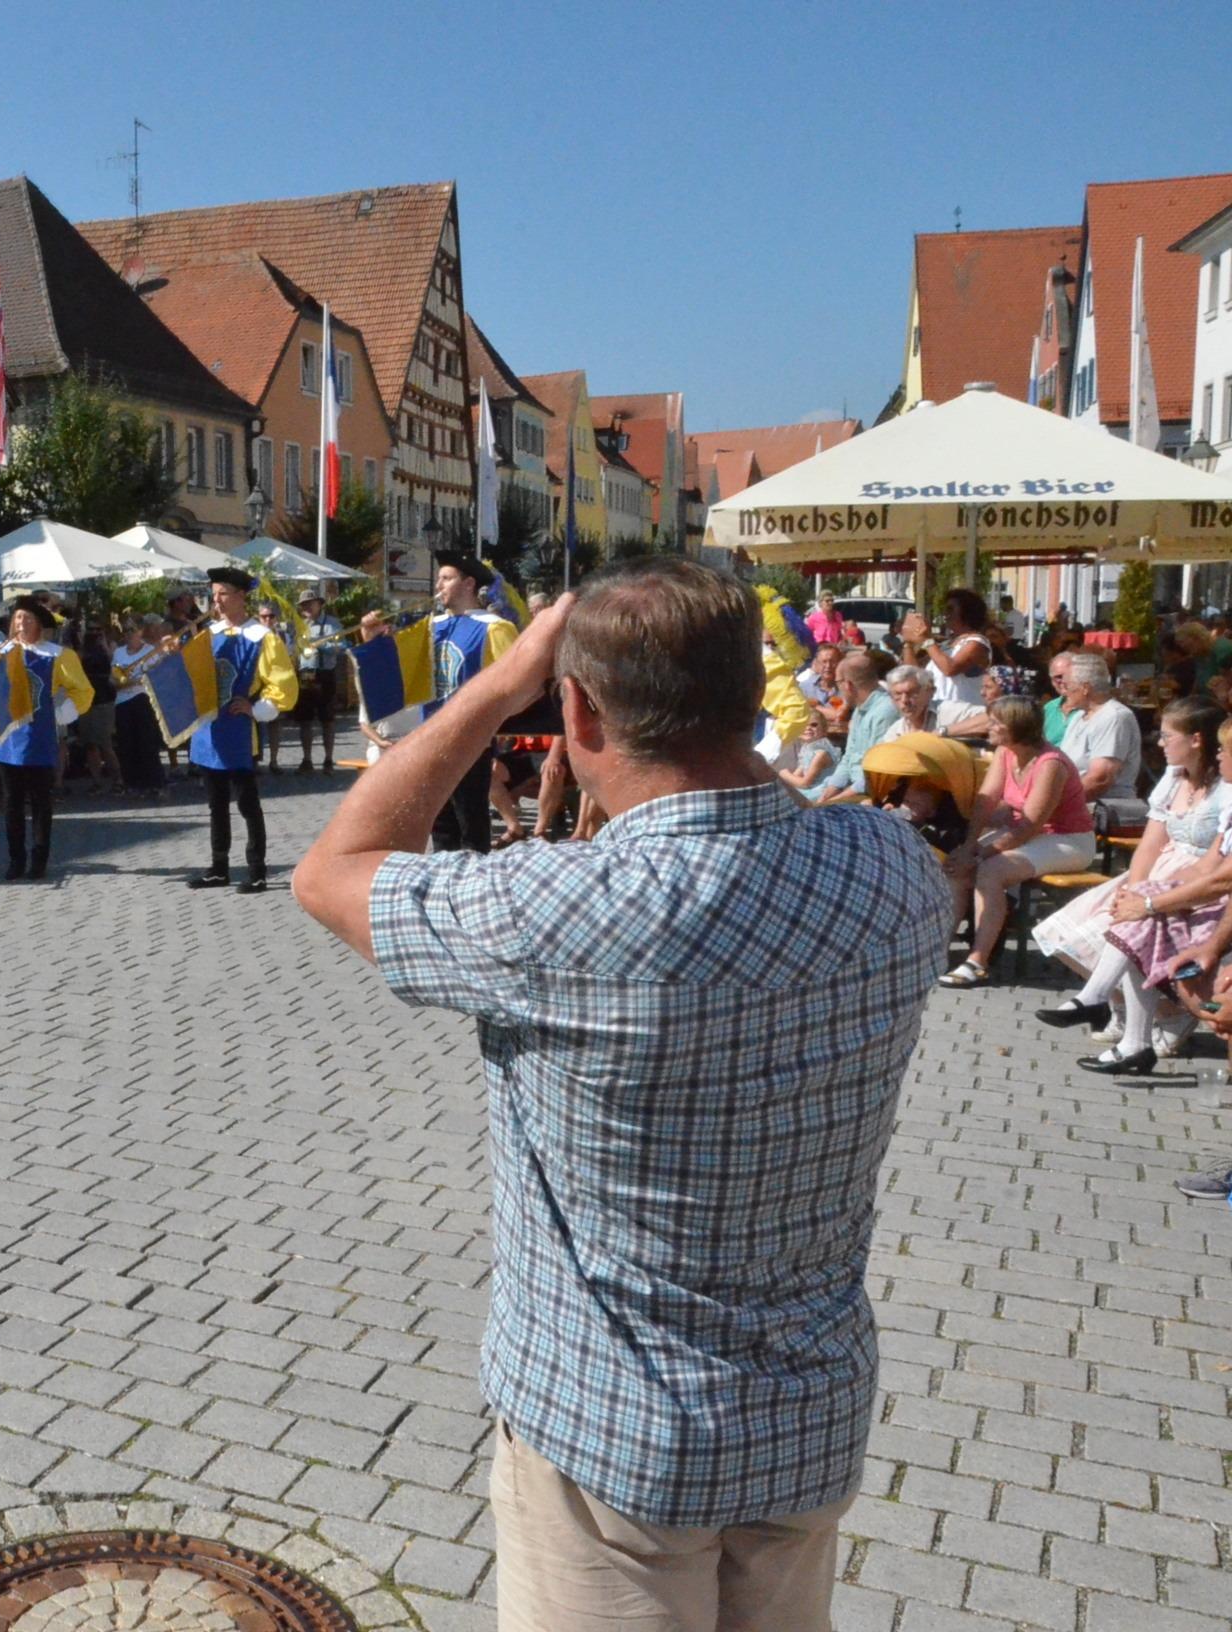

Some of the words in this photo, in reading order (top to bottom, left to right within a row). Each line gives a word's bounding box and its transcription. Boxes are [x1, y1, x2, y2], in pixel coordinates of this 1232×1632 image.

[859, 480, 1010, 500] Spalter
[1019, 478, 1115, 496] Bier
[739, 503, 890, 536] Mönchshof
